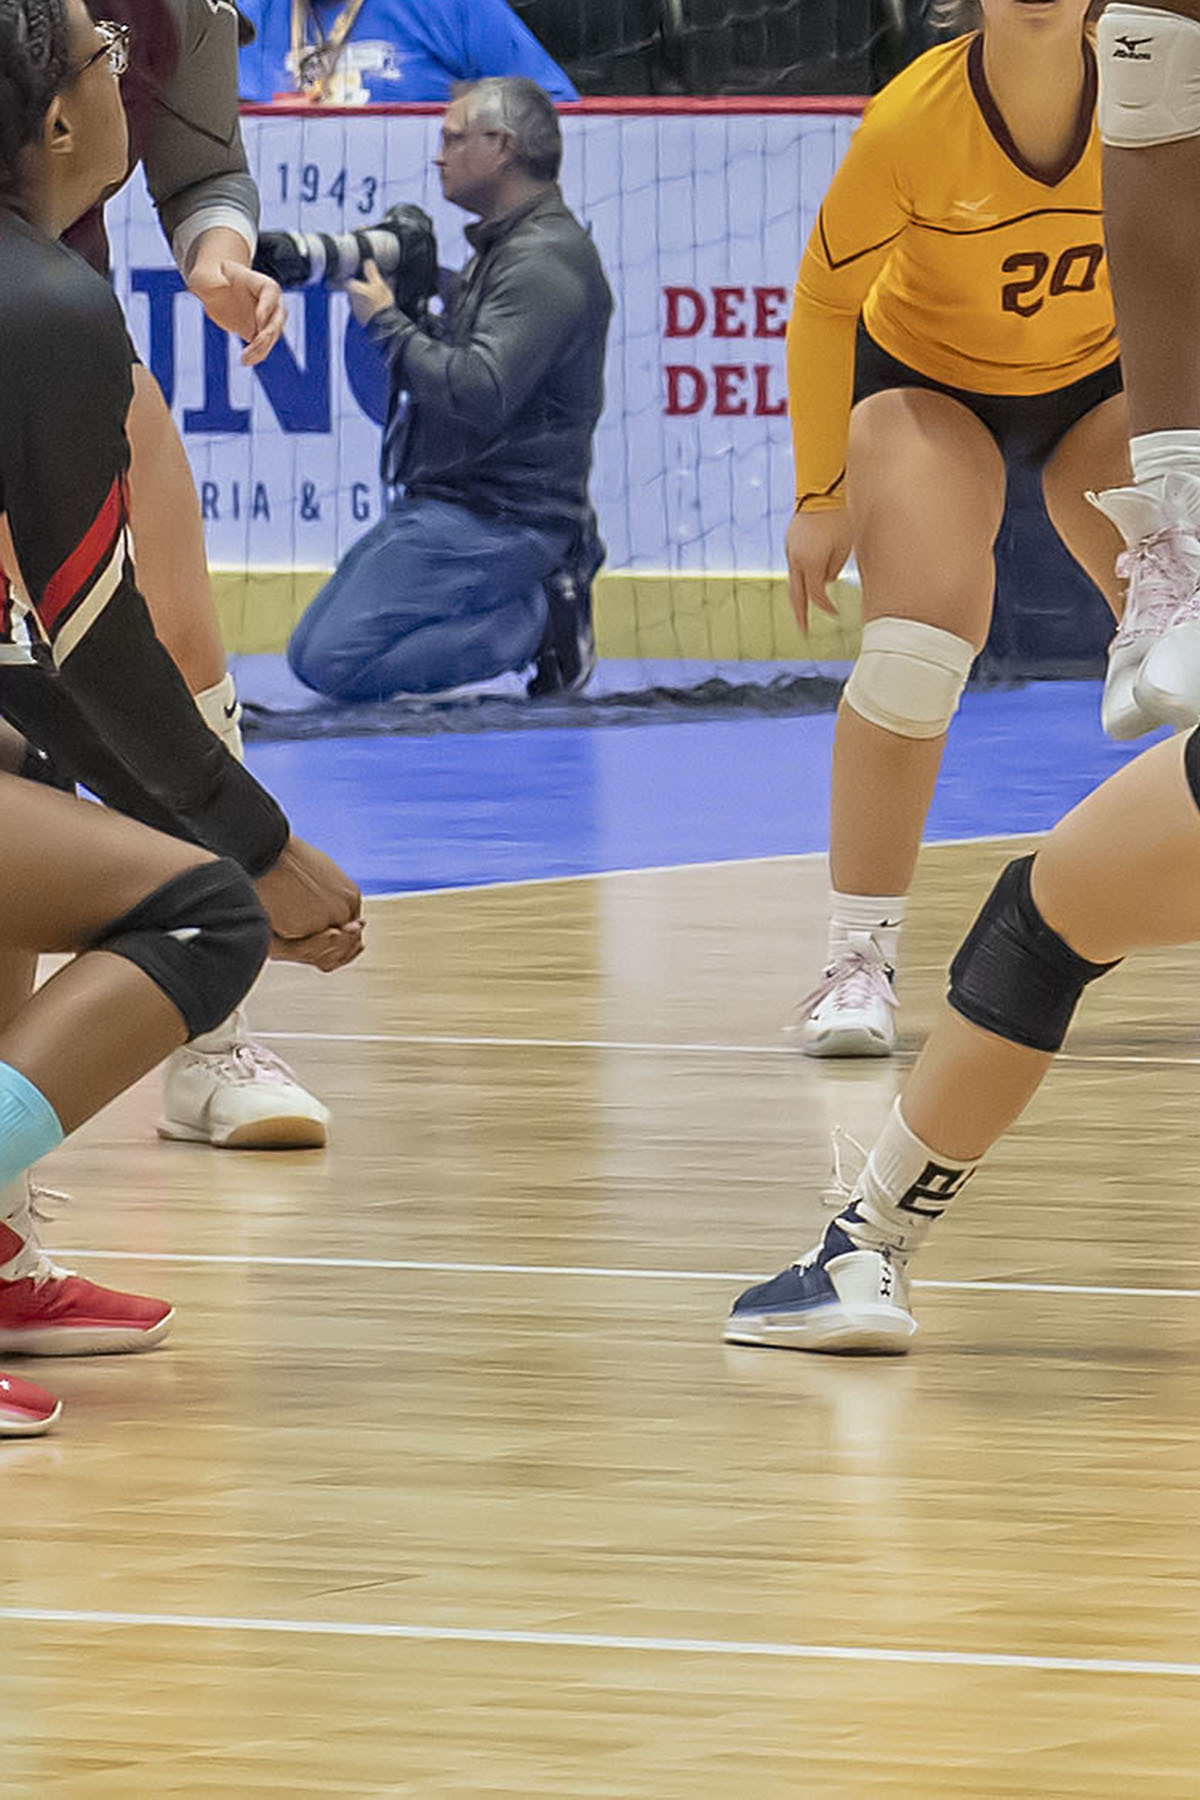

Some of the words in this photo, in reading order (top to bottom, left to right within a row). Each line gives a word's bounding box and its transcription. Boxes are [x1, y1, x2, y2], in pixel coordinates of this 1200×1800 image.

[278, 163, 379, 214] 1943
[1002, 244, 1103, 317] 20
[663, 285, 788, 338] DEE
[664, 365, 788, 416] DEL
